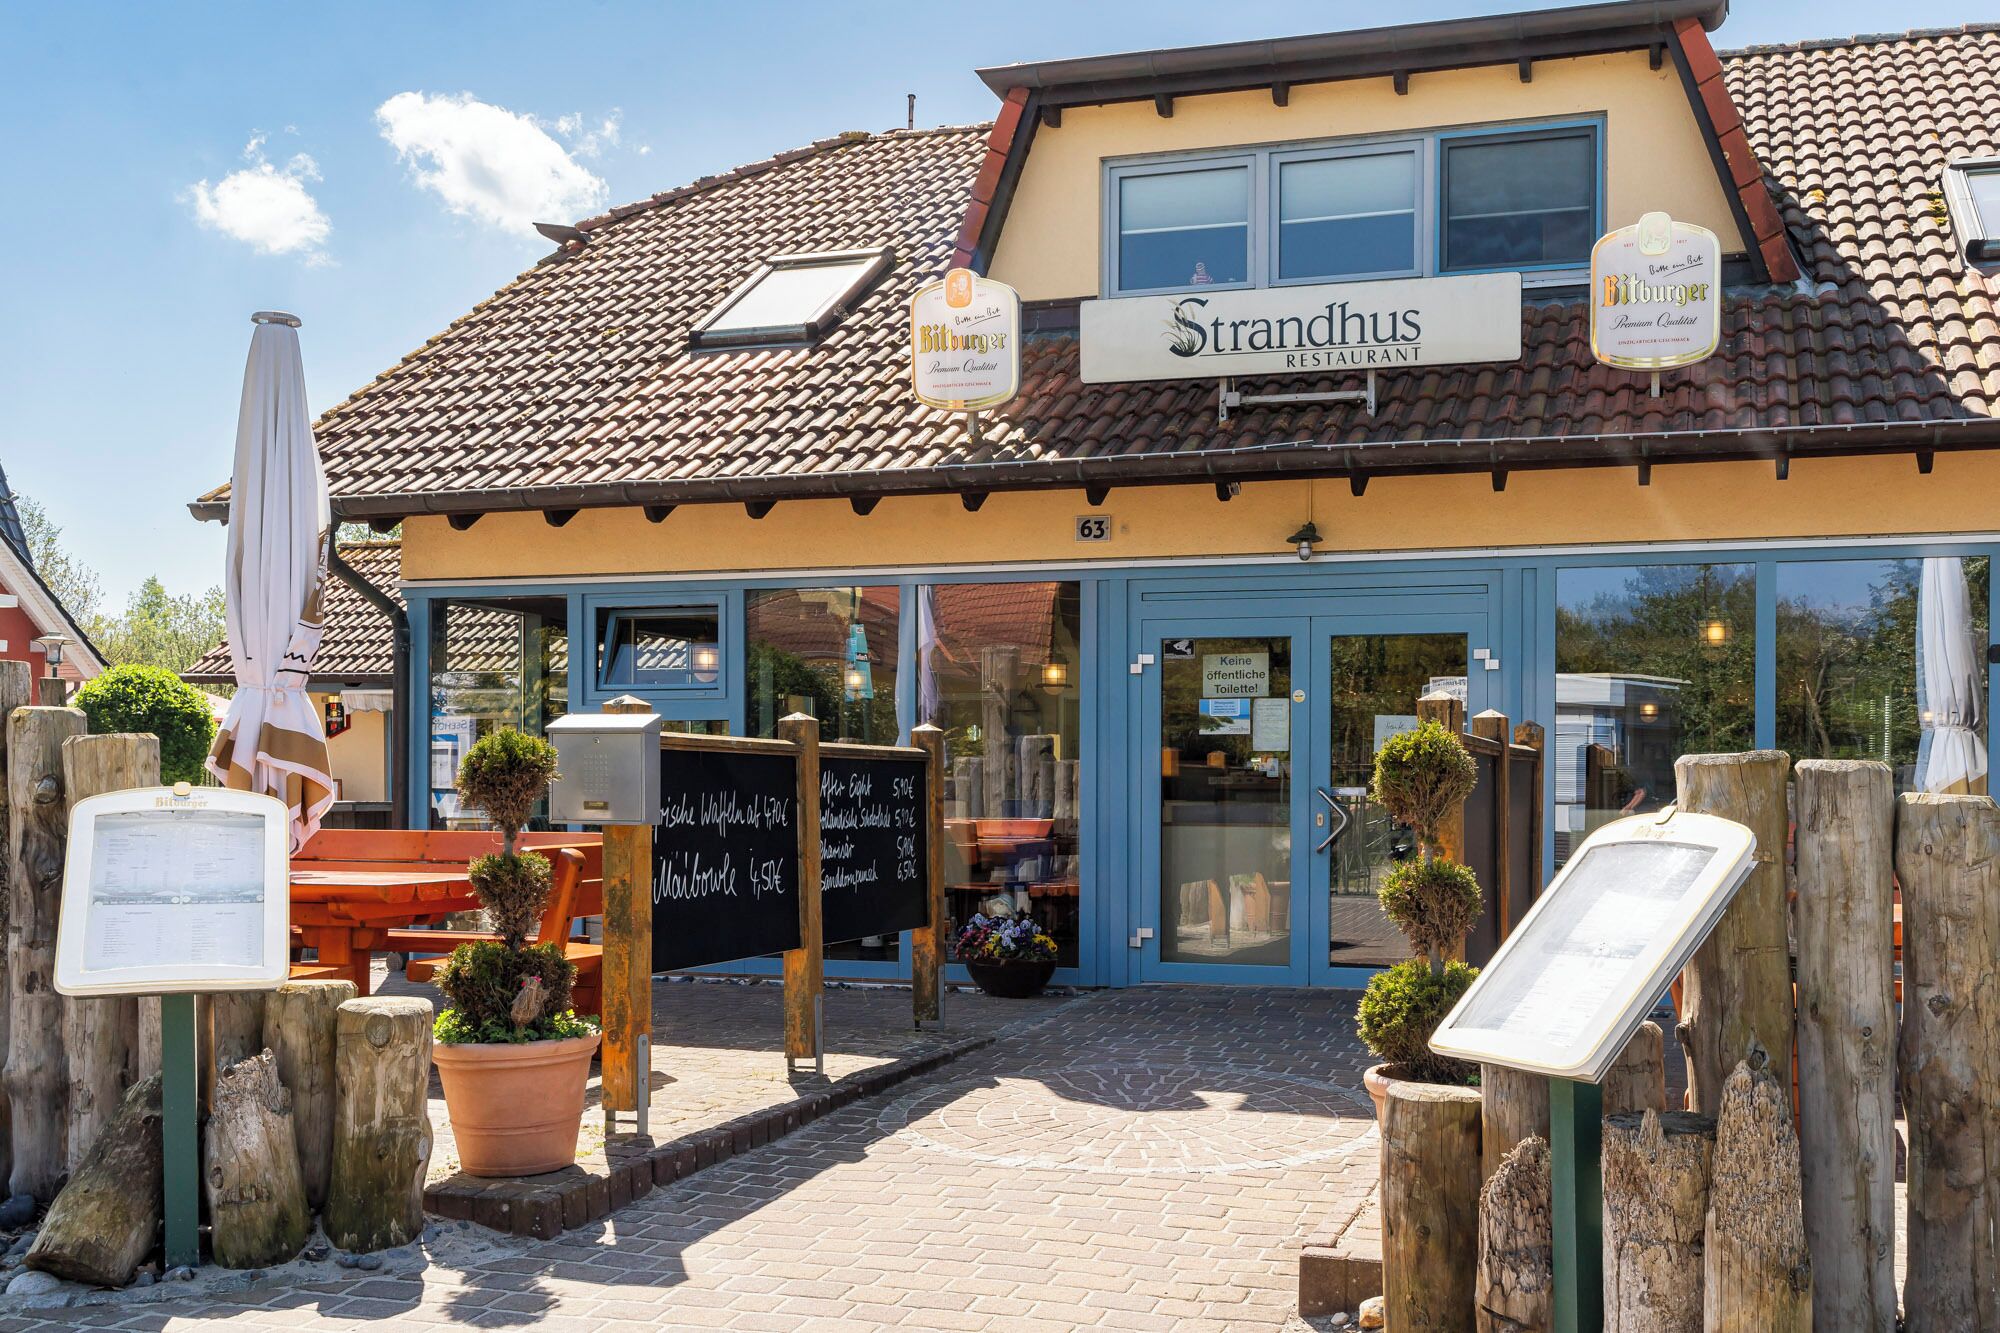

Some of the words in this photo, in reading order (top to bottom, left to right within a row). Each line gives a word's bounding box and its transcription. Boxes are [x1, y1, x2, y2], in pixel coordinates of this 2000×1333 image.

[1648, 264, 1669, 275] Bitte
[1686, 254, 1704, 265] Bit
[1601, 273, 1709, 307] Bitburger
[955, 316, 971, 326] Bitte
[986, 307, 1001, 317] Bit
[1609, 314, 1653, 330] Premium
[1656, 312, 1698, 328] Qualität
[1168, 297, 1422, 358] Strandhus
[919, 323, 1007, 354] Bitburger
[927, 360, 960, 375] Premium
[963, 358, 998, 373] Qualität
[1286, 346, 1422, 368] RESTAURANT
[1080, 519, 1105, 539] 63
[1220, 656, 1252, 666] Keine
[1206, 670, 1266, 680] öffentliche
[1214, 684, 1258, 694] Toilette!
[820, 770, 845, 804] After
[849, 772, 872, 809] Eight
[653, 792, 695, 844] rische
[701, 789, 745, 838] Waffeln
[764, 795, 789, 830] 4,70€
[653, 851, 737, 904] Maibowle
[750, 857, 786, 900] 4,50€
